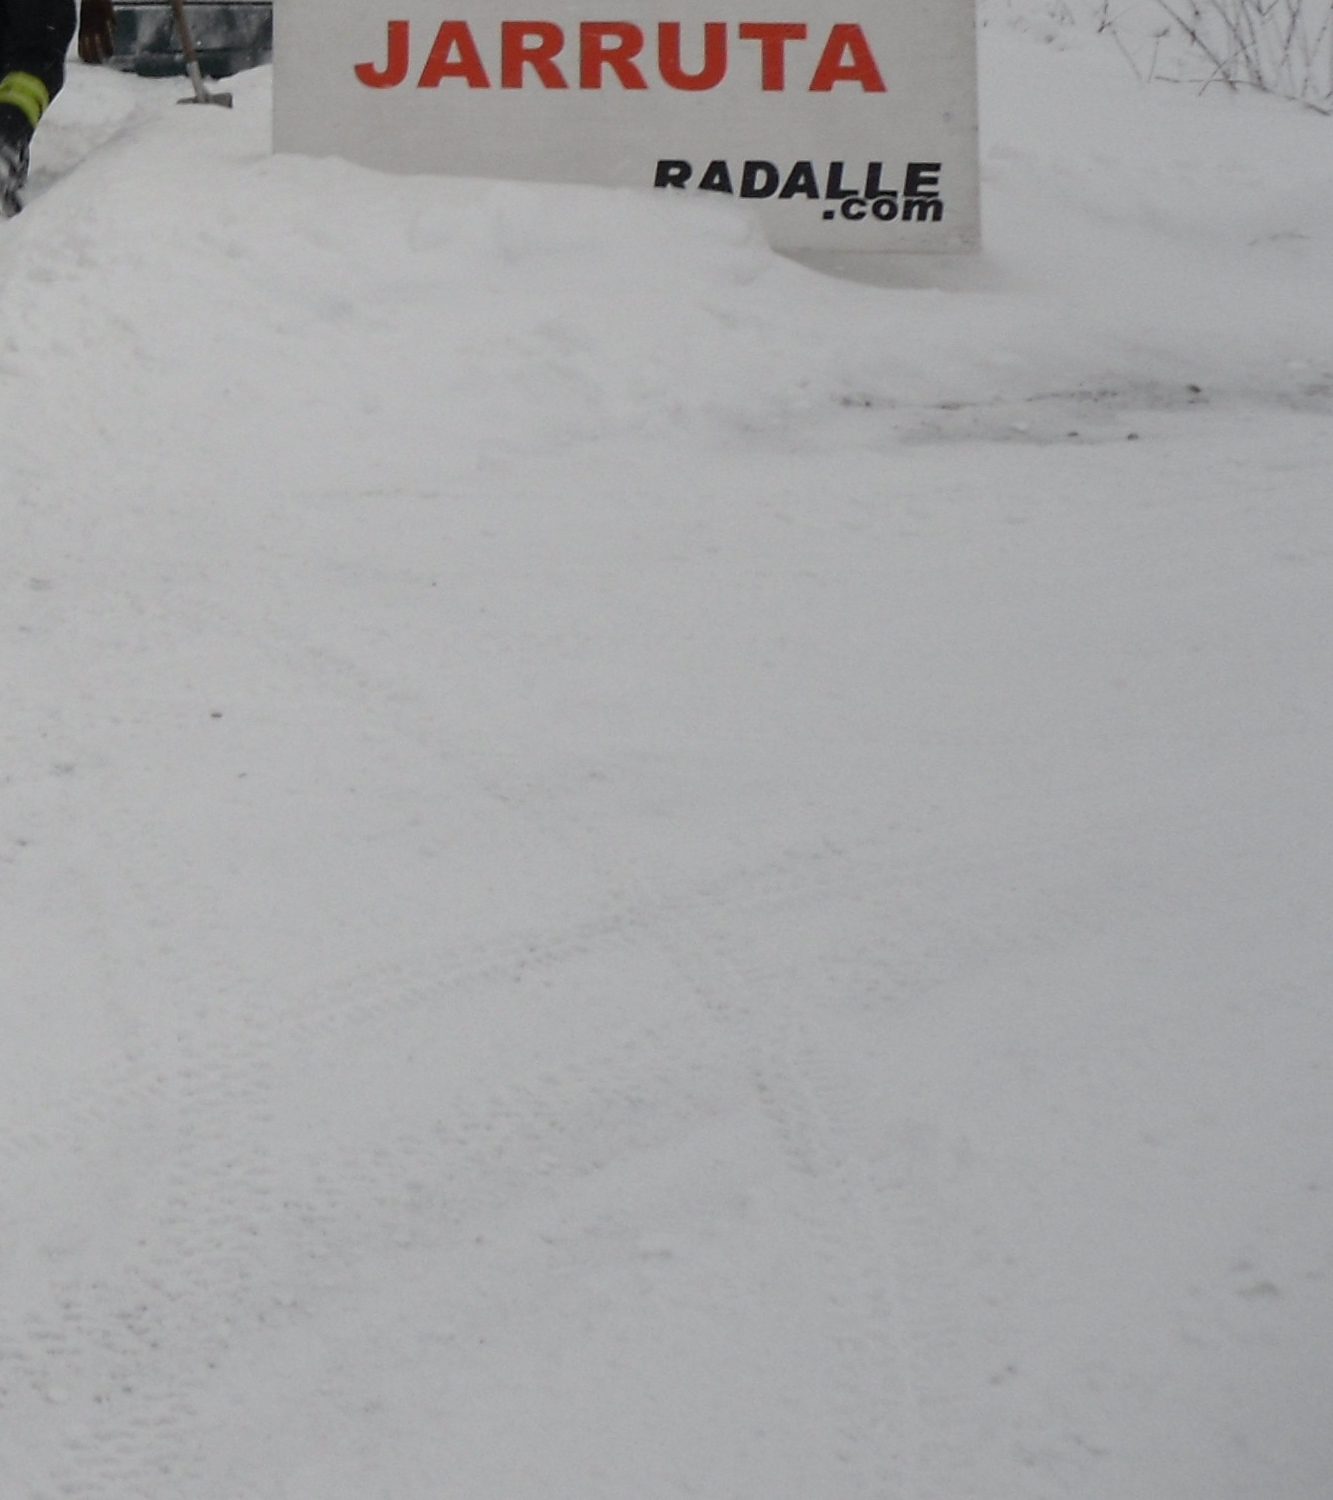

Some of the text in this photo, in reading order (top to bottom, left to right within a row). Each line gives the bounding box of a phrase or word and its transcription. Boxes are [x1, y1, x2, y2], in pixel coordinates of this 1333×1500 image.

[353, 19, 887, 93] JARRUTA
[654, 159, 942, 199] RADALLE
[822, 197, 944, 221] .com
